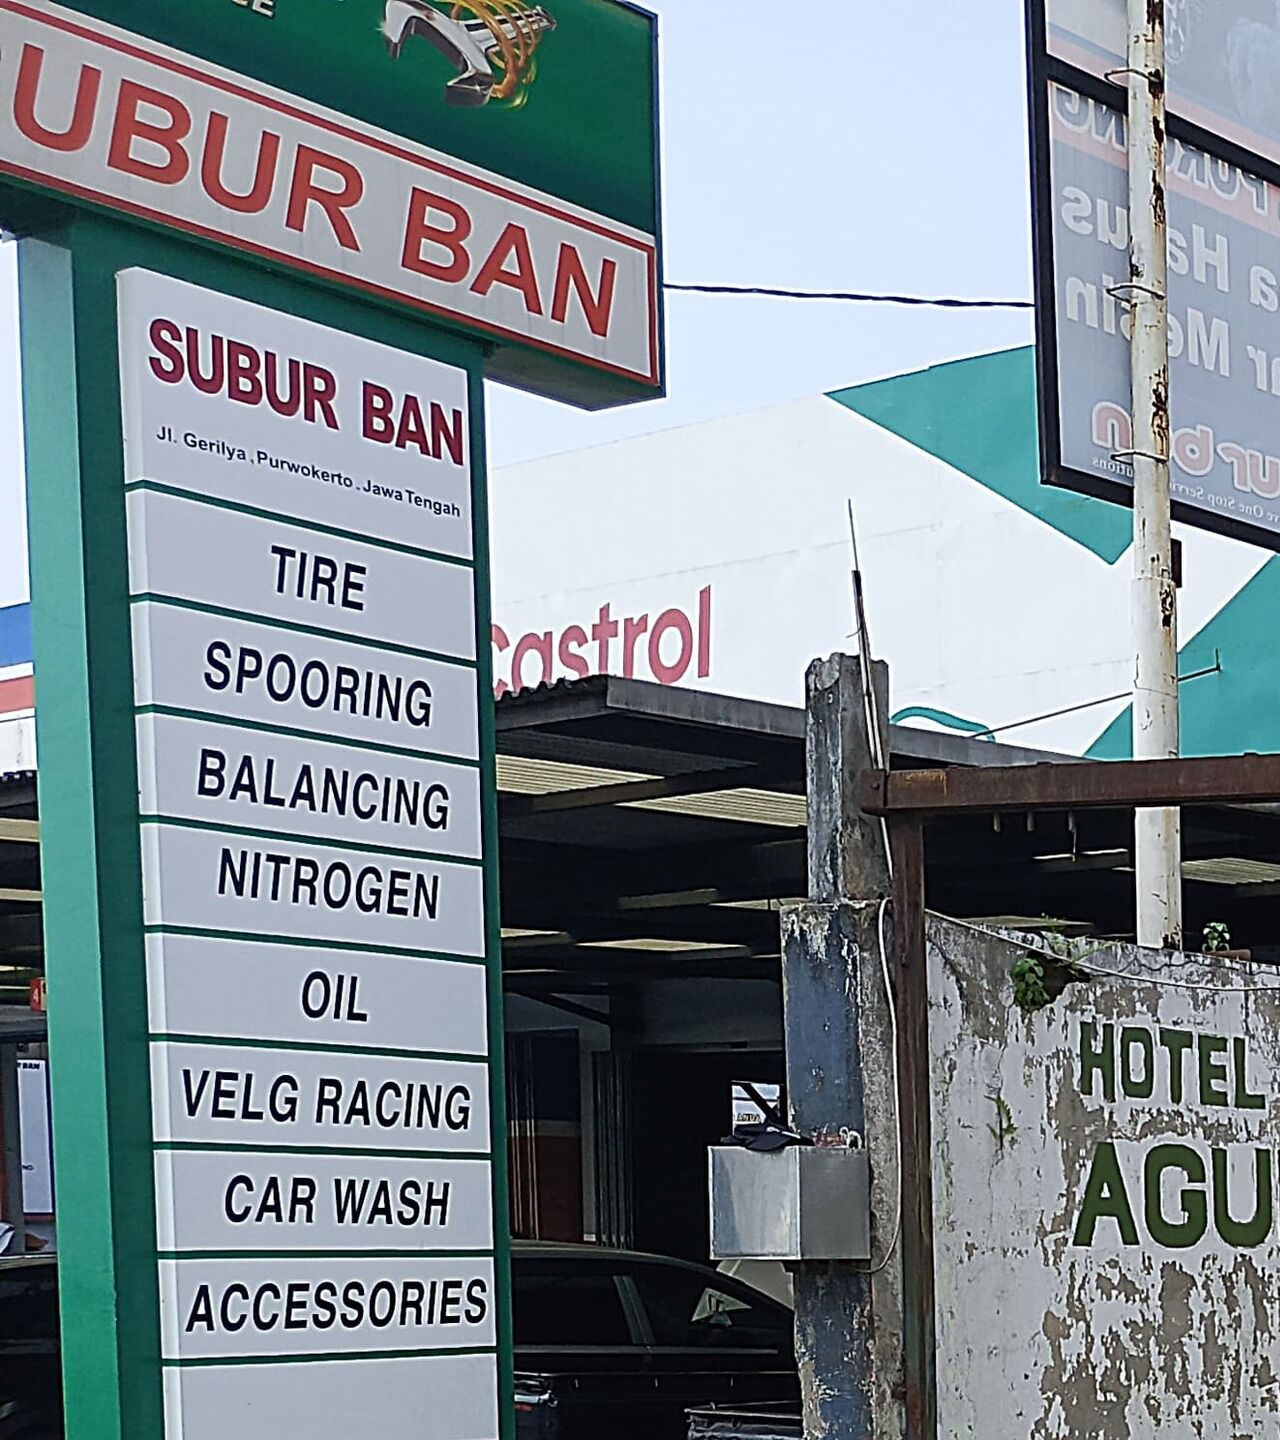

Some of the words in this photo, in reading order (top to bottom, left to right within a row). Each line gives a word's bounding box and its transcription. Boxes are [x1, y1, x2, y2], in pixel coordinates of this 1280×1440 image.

[0, 43, 362, 254] UBUR
[400, 187, 617, 337] BAN
[148, 318, 340, 431] SUBUR
[362, 380, 465, 466] BAN
[156, 425, 177, 444] Jl.
[405, 489, 461, 518] Tengah
[270, 545, 368, 612] TIRE
[202, 639, 434, 728] SPOORING
[196, 748, 450, 830] BALANCING
[216, 847, 439, 919] NITROGEN
[300, 970, 368, 1022] OIL
[182, 1069, 299, 1123] VELG
[315, 1077, 471, 1131] RACING
[1078, 1021, 1266, 1110] HOTEL
[223, 1174, 317, 1224] CAR
[333, 1178, 450, 1226] WASH
[185, 1278, 487, 1333] ACCESSORIES
